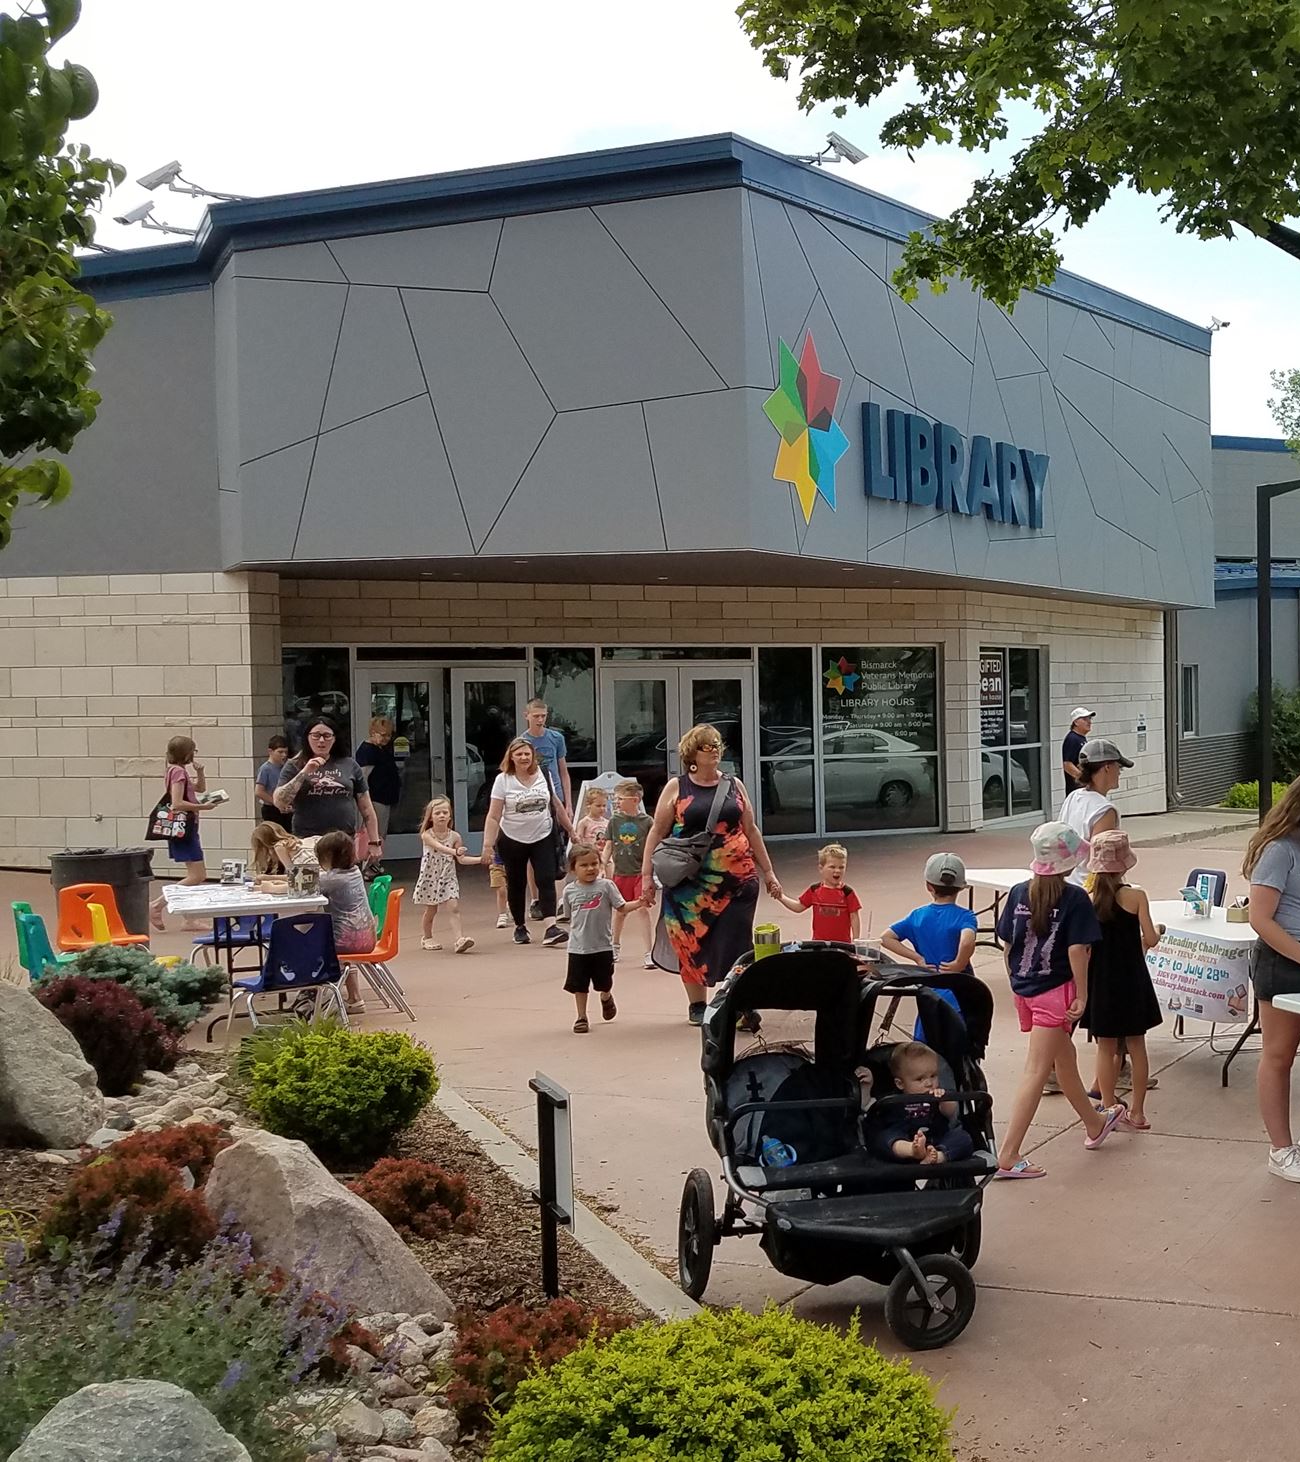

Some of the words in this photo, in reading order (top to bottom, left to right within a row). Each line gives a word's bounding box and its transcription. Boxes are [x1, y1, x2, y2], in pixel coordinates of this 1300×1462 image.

[861, 401, 1050, 529] LIBRARY
[861, 660, 897, 669] Bismarck
[980, 659, 1001, 673] GIFTED
[861, 671, 896, 680] Veterans
[898, 670, 935, 680] Memorial
[861, 682, 886, 690] Public
[888, 681, 917, 692] Library
[981, 677, 1002, 692] ean
[840, 698, 879, 707] LIBRARY
[881, 697, 915, 706] HOURS
[1168, 935, 1199, 952] Reading
[1198, 941, 1245, 960] Challenge
[1172, 960, 1182, 971] to
[1184, 962, 1204, 979] July
[1206, 967, 1230, 982] 28th
